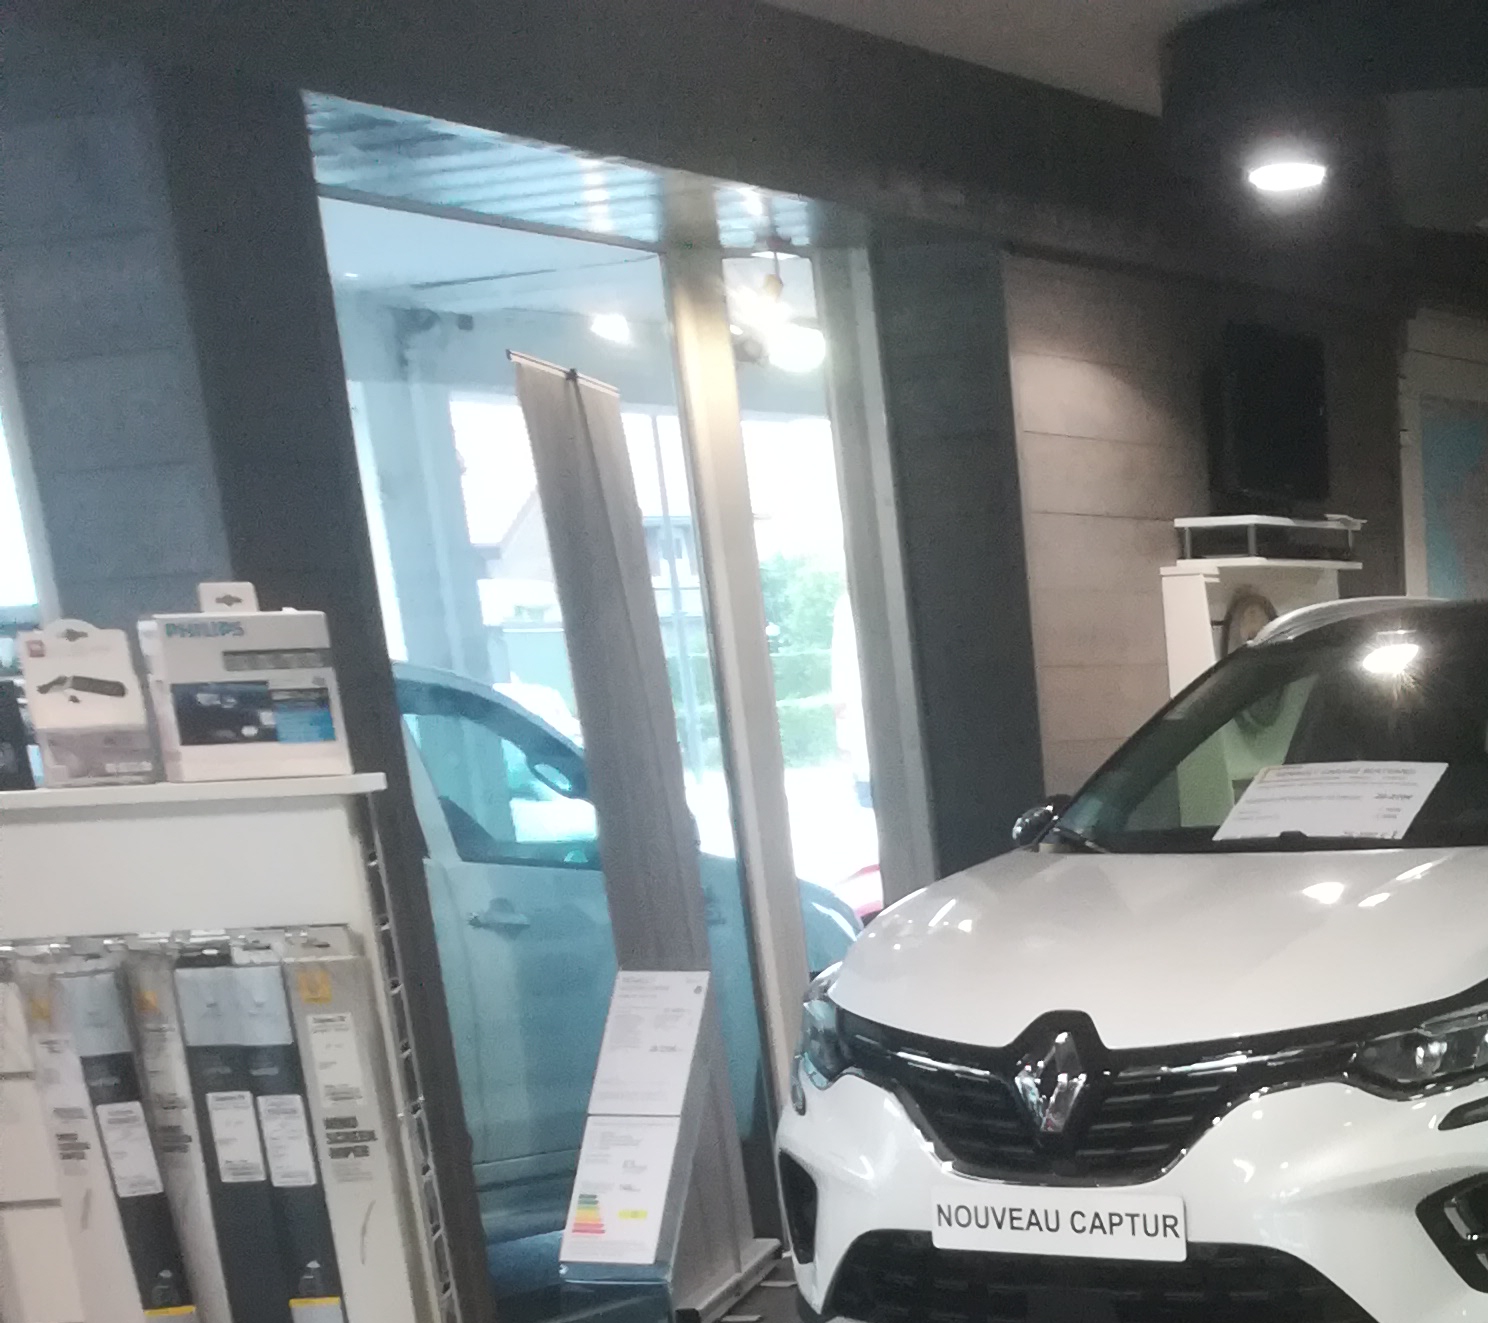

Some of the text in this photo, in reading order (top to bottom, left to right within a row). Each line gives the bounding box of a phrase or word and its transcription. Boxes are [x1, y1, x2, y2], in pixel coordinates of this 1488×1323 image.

[165, 621, 245, 638] PHILIPS
[936, 1203, 1181, 1239] NOUVEAU CAPTUR
